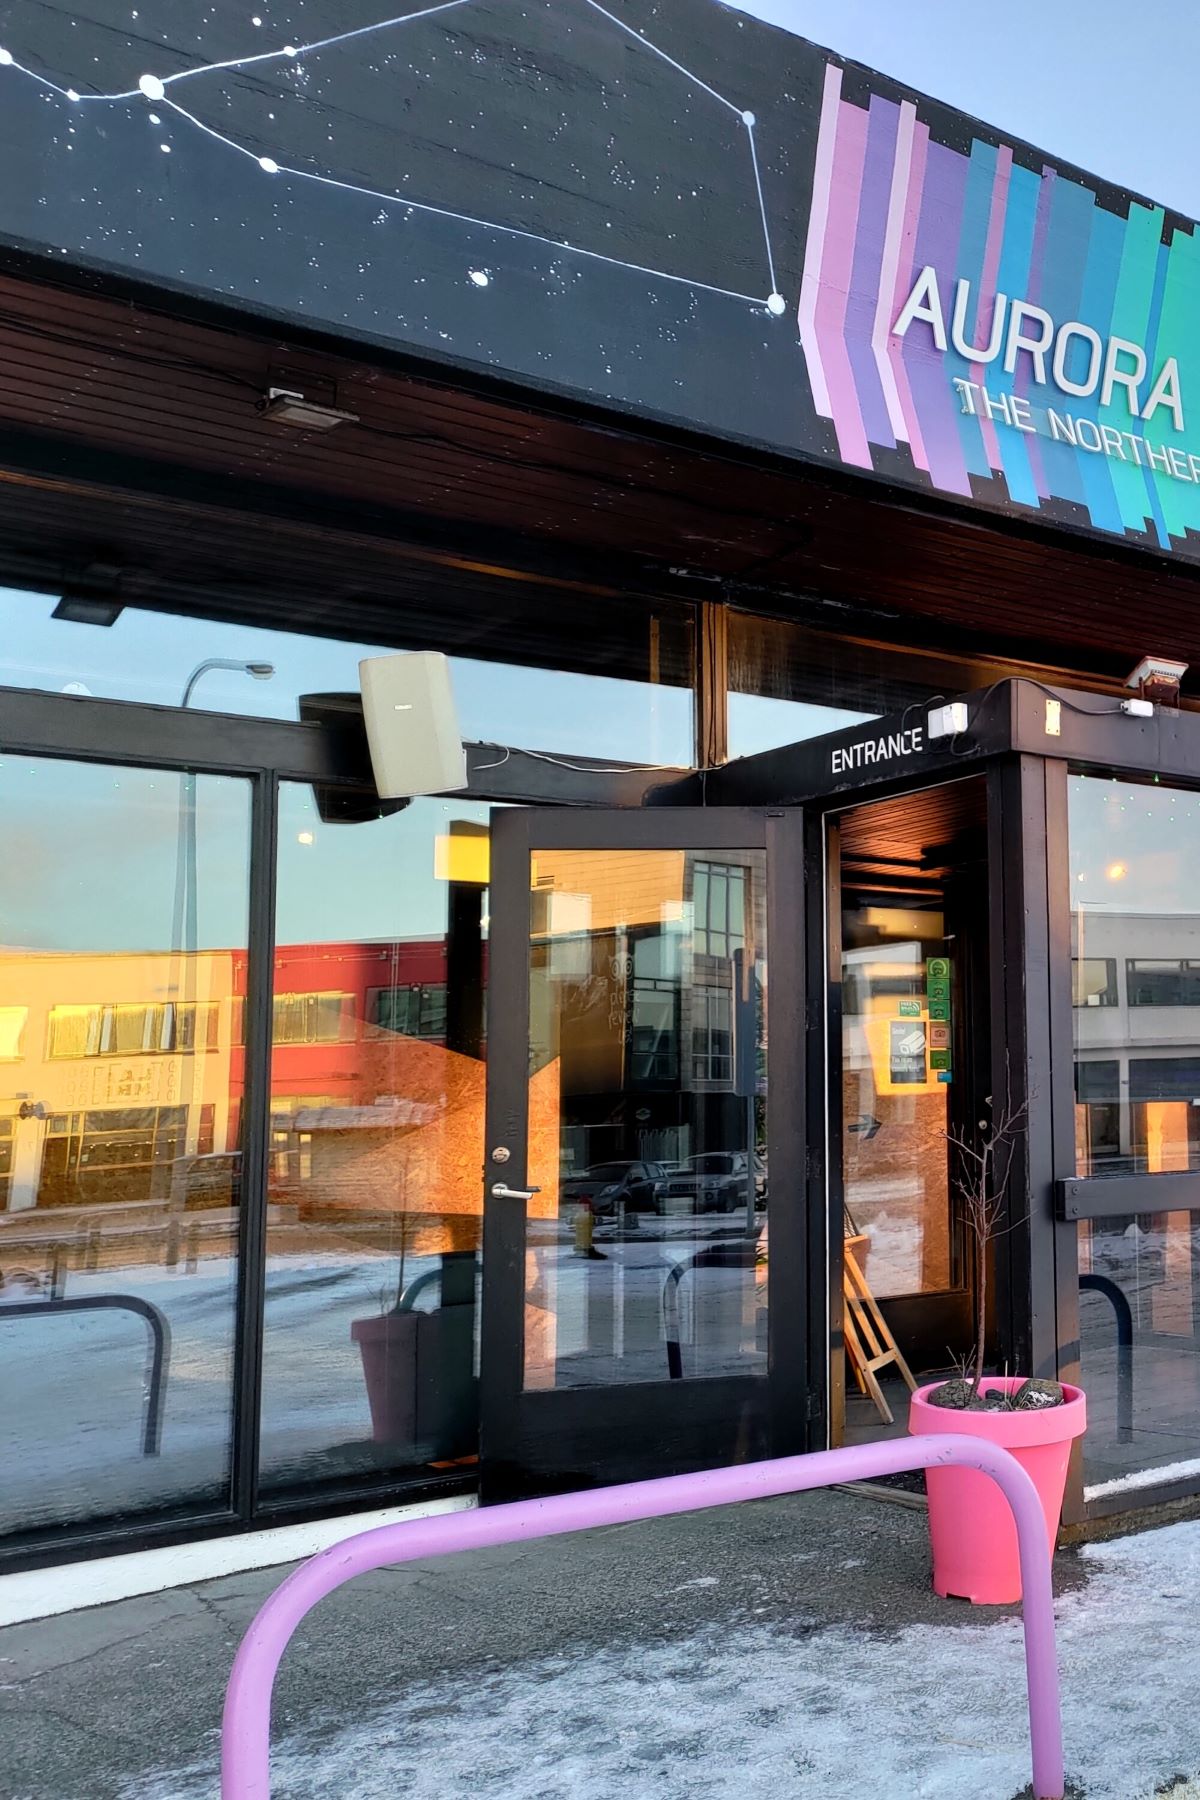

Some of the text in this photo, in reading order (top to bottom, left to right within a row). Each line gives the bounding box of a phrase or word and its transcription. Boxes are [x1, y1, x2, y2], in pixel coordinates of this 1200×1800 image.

[892, 265, 1186, 432] AURORA
[953, 376, 1037, 434] THE
[831, 727, 923, 774] ENTRANCE
